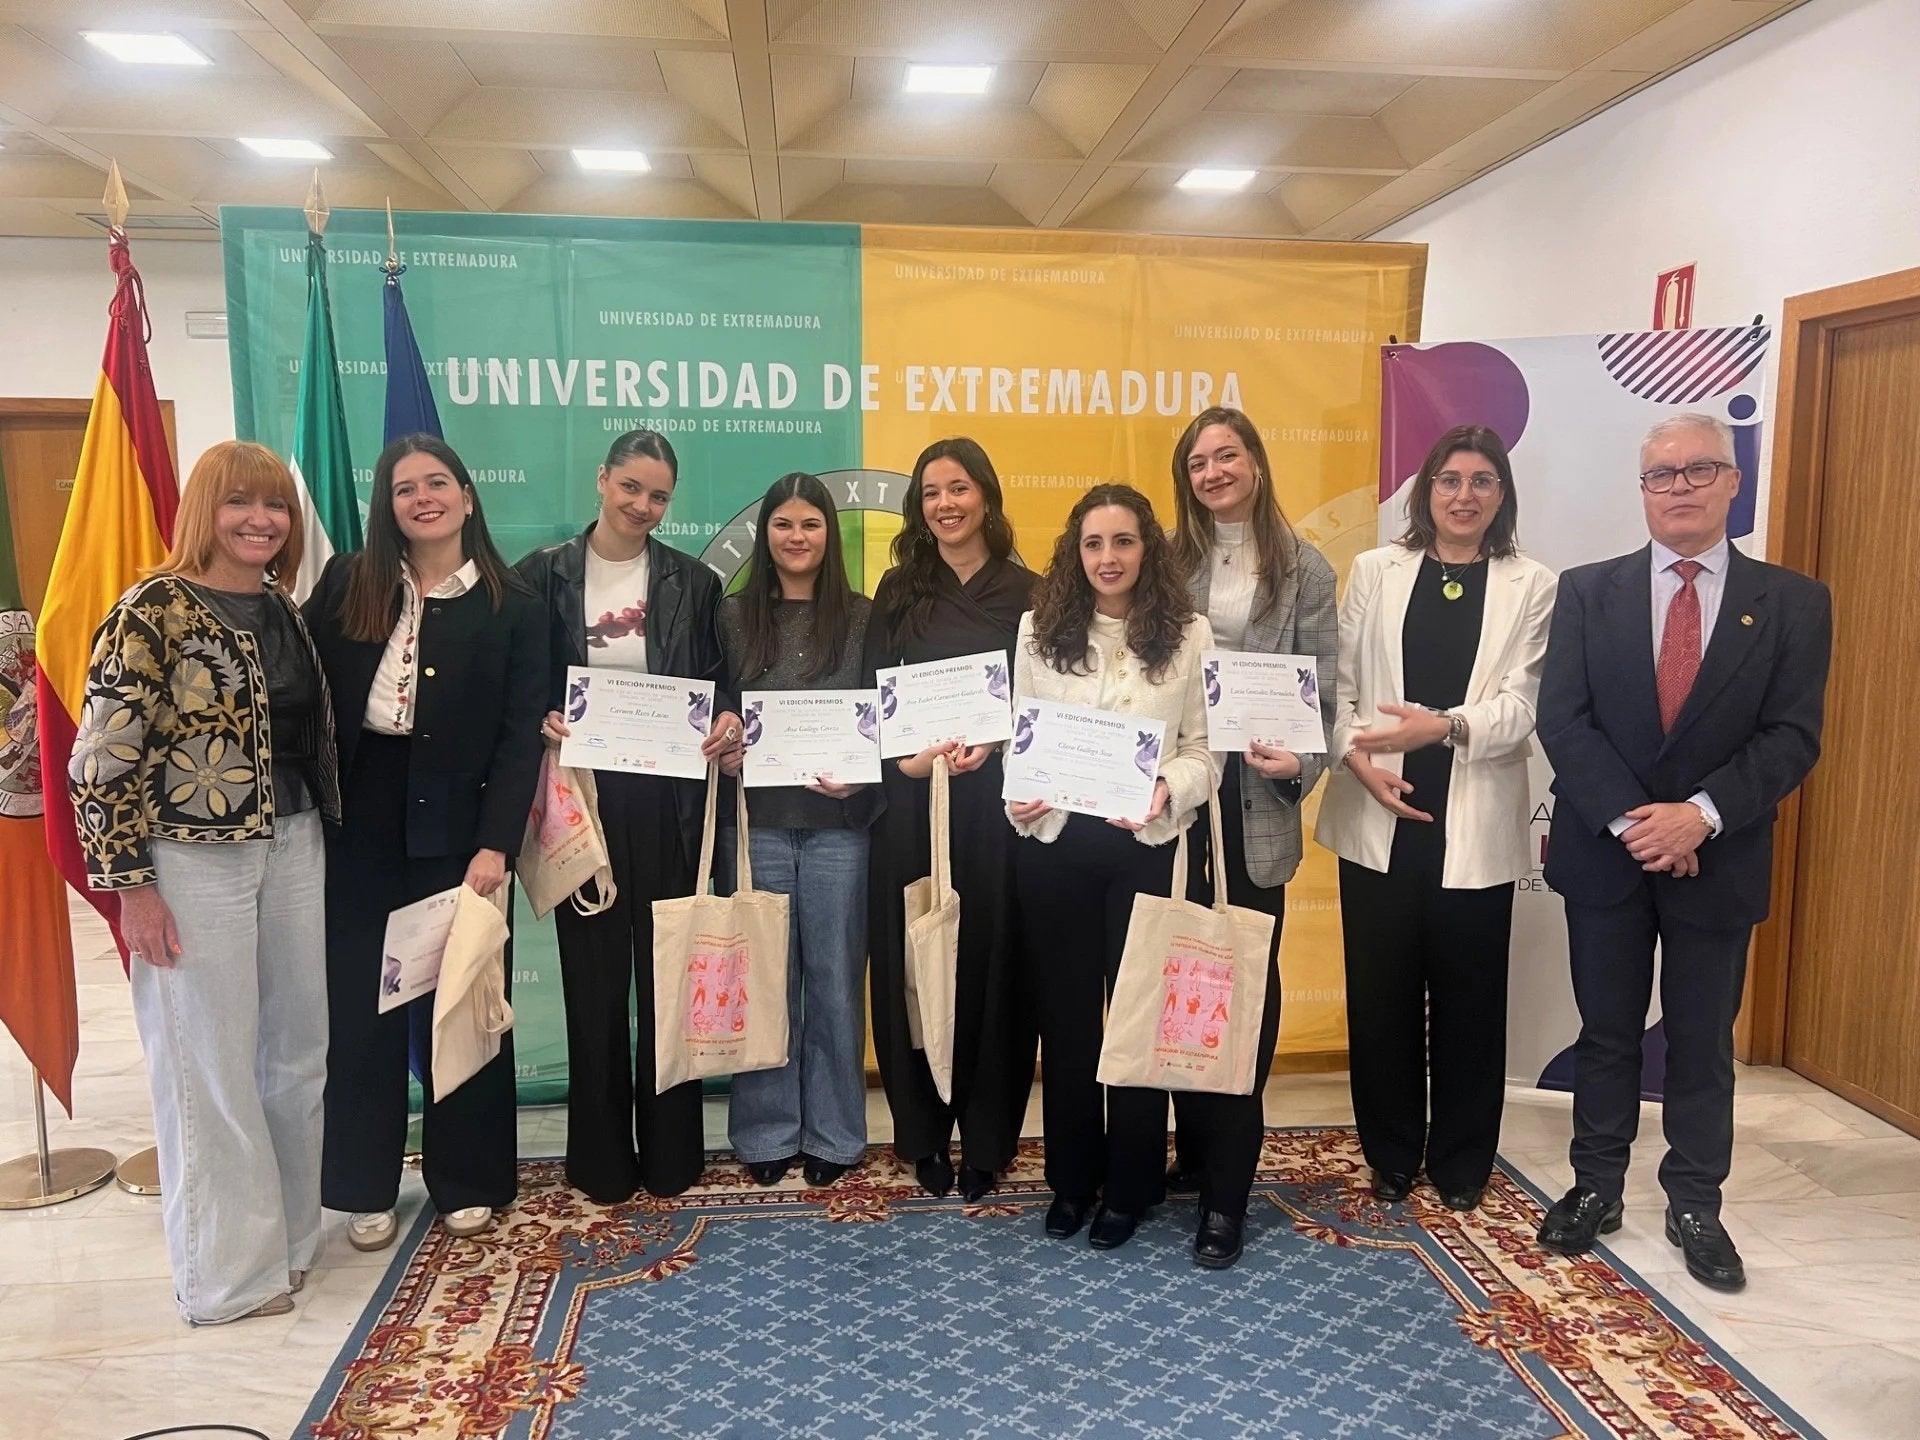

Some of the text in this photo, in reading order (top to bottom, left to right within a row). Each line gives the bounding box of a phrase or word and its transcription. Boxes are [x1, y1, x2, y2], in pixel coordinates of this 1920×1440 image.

[280, 248, 381, 265] UNIRSIDAD
[414, 251, 518, 268] EXTREMADURA
[895, 265, 1105, 284] UNIVERSIDAD DE EXTREMADURA
[600, 311, 822, 329] UNIVERSIDAD DE EXTREMADURA
[1175, 325, 1375, 343] UNIVERSIDAD DE EXTREMADURA
[448, 357, 1243, 416] UNIVERSIDAD DE EXTREMADURA
[603, 417, 822, 434] UNIVERSIDAD DE EXTREMADURA
[1282, 429, 1369, 443] EXTREMADURA
[1011, 475, 1101, 488] EXTREMADURA
[946, 665, 973, 673] PREMIOS
[616, 680, 644, 688] EDICIÓN
[645, 683, 677, 691] PREMIOS
[1095, 719, 1126, 729] PREMIOS
[1518, 878, 1542, 891] DE
